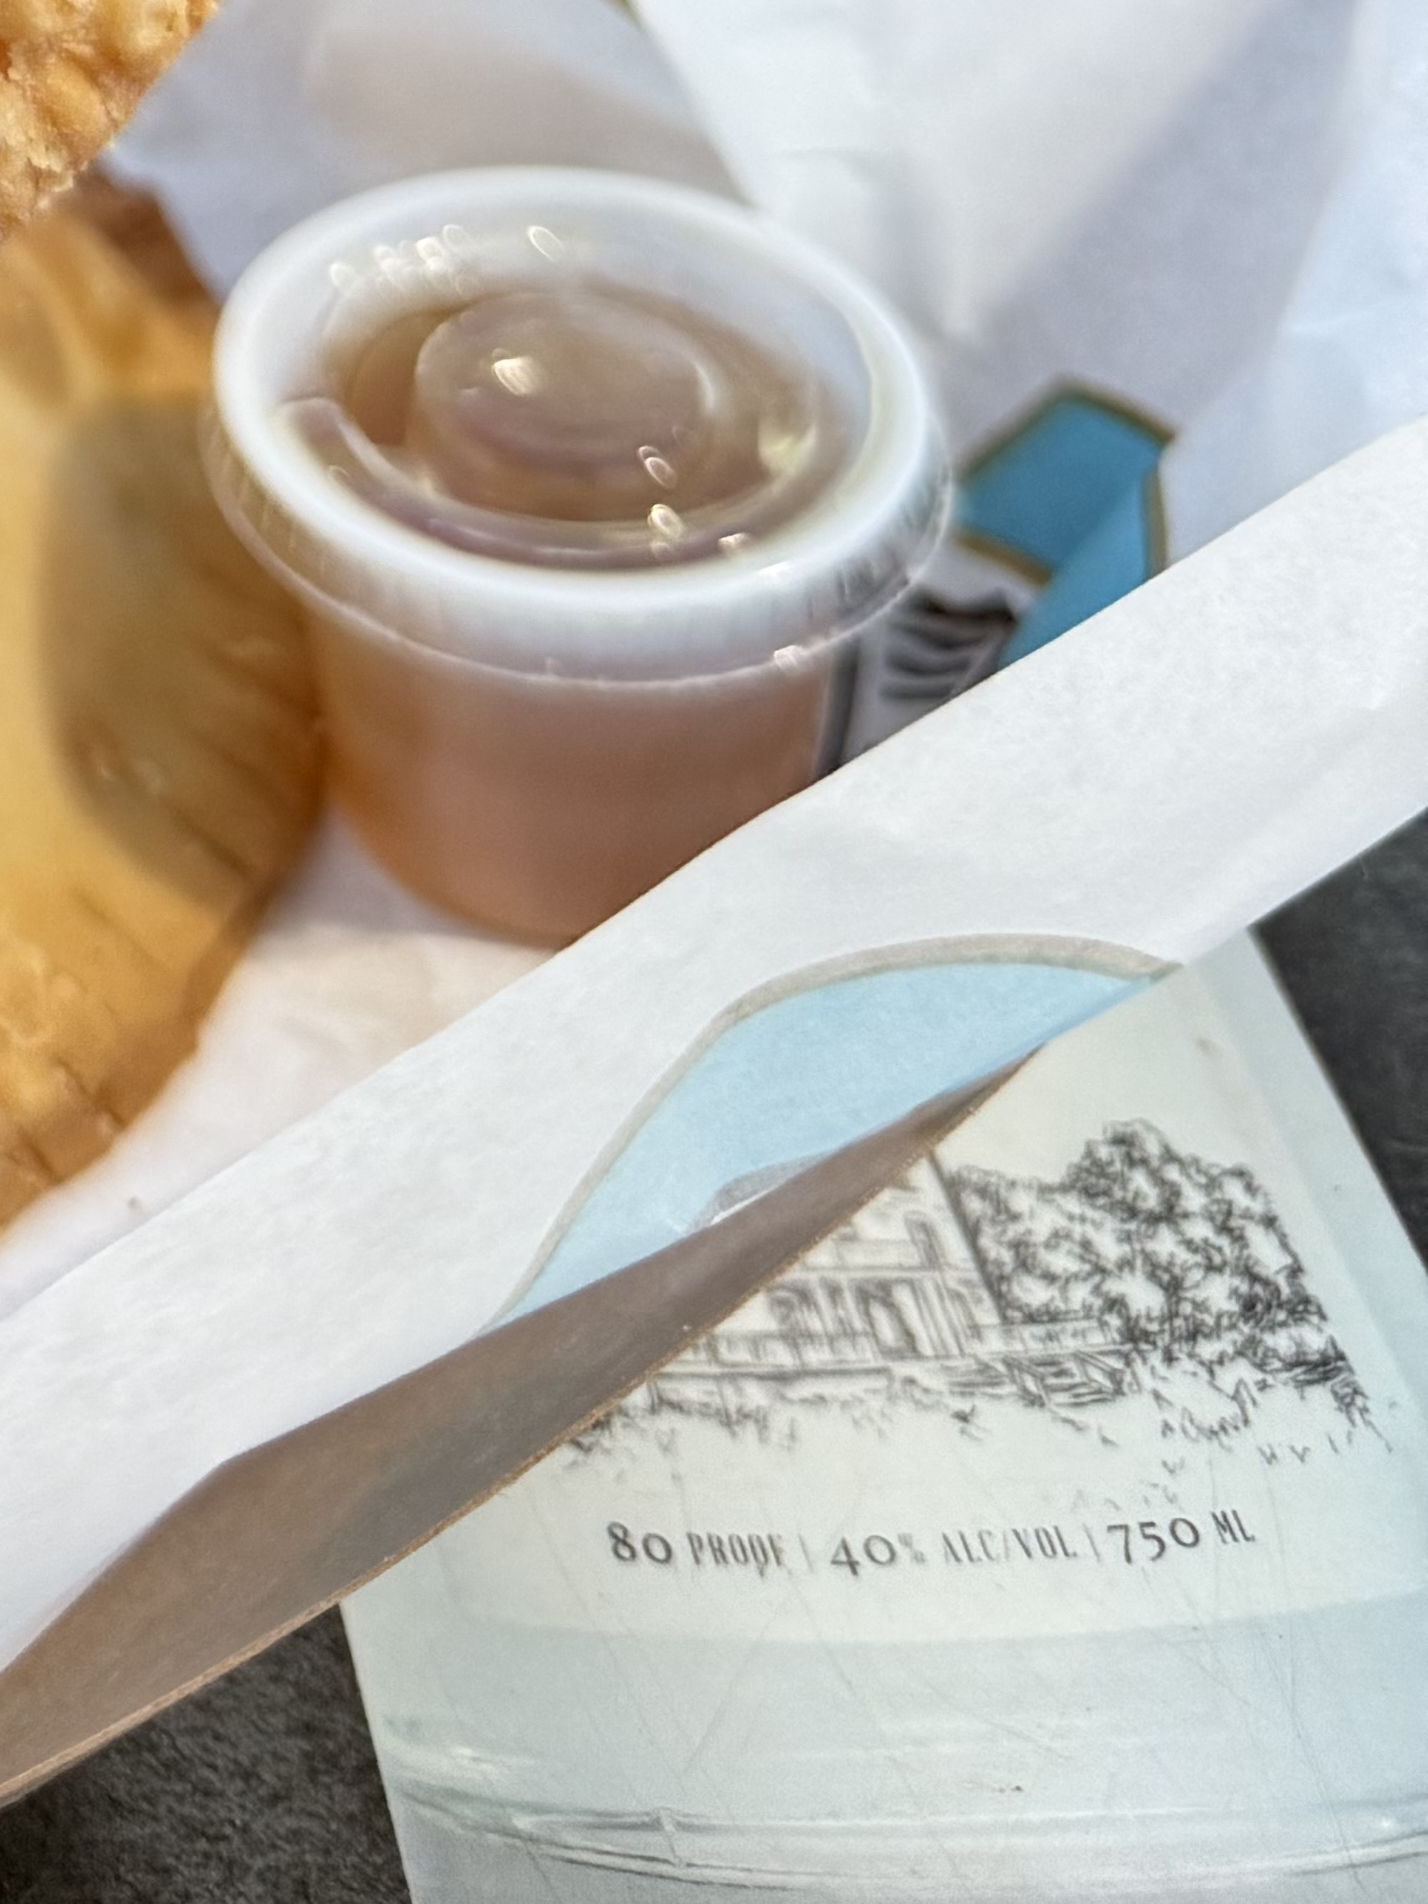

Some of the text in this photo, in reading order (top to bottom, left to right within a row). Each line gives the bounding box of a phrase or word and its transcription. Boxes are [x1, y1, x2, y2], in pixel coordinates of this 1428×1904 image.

[605, 1508, 1257, 1576] 80 PROOF 40% ALC/VOL 750 ML
